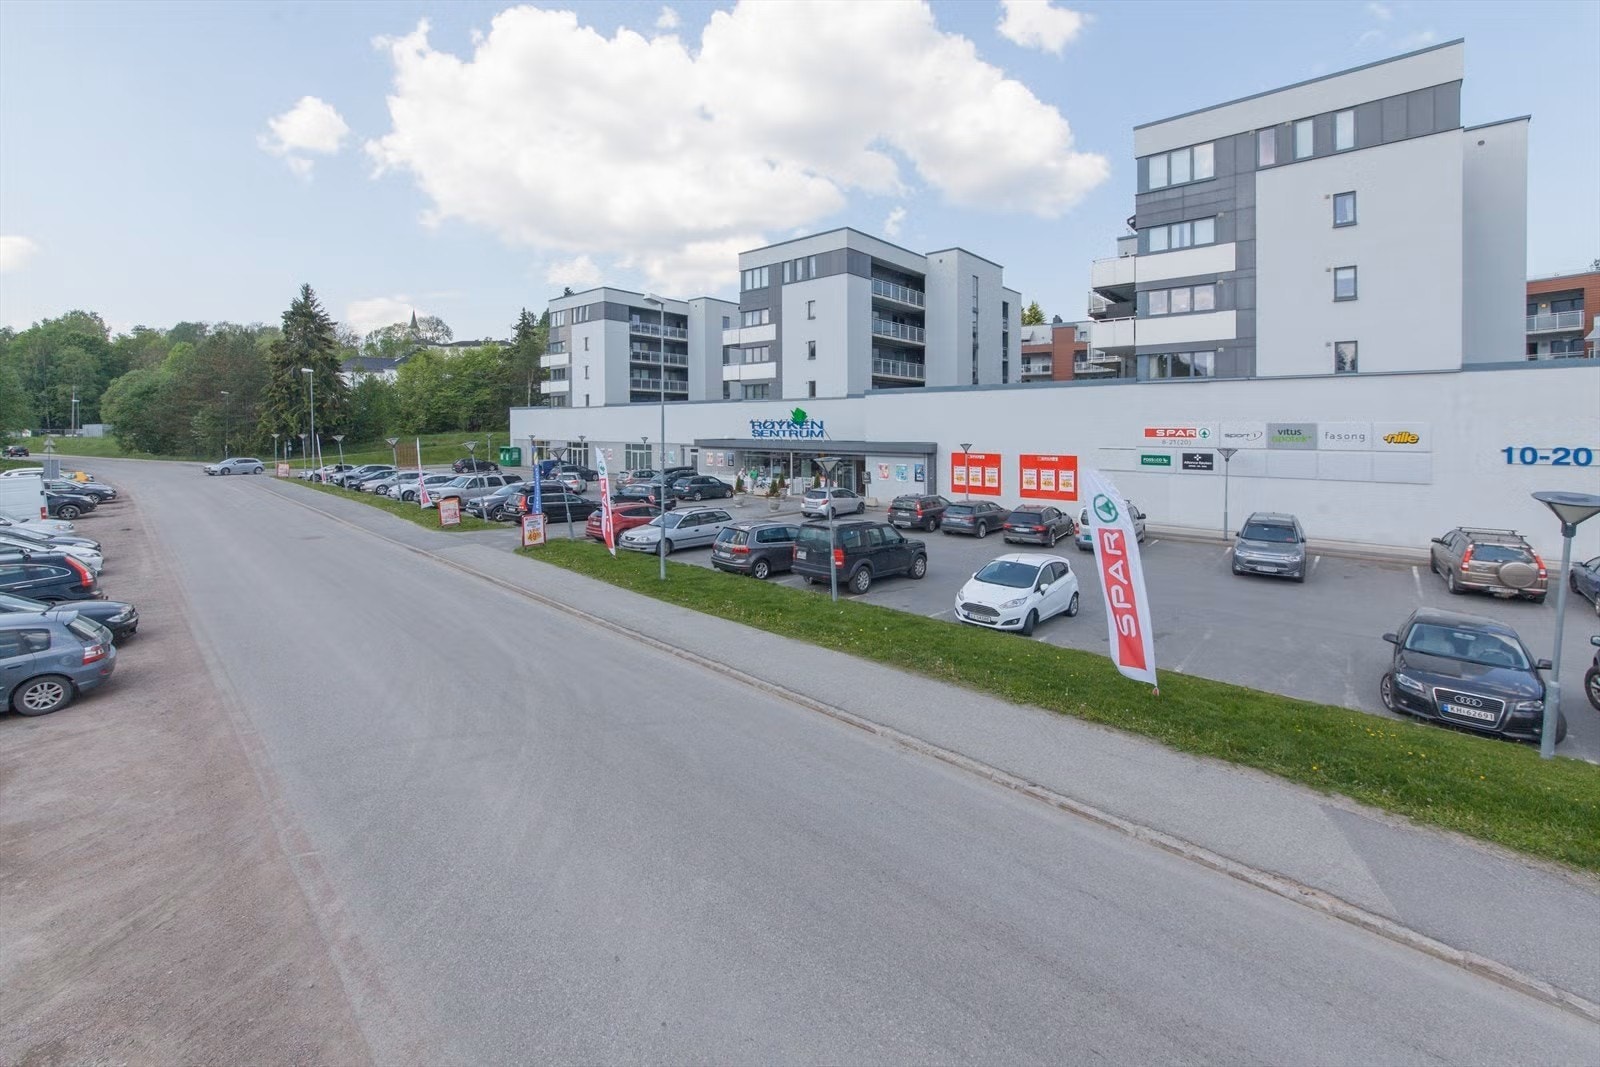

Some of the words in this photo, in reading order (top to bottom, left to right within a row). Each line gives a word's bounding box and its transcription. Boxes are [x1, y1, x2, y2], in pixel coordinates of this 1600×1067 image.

[751, 419, 824, 430] RØYKEN
[751, 429, 824, 438] SENTRUM
[1156, 428, 1196, 437] SPAR
[1277, 428, 1302, 436] vitus
[1324, 431, 1366, 442] fasong
[1387, 431, 1419, 444] nille
[1501, 446, 1593, 467] 10-20
[1104, 531, 1137, 638] SPAR
